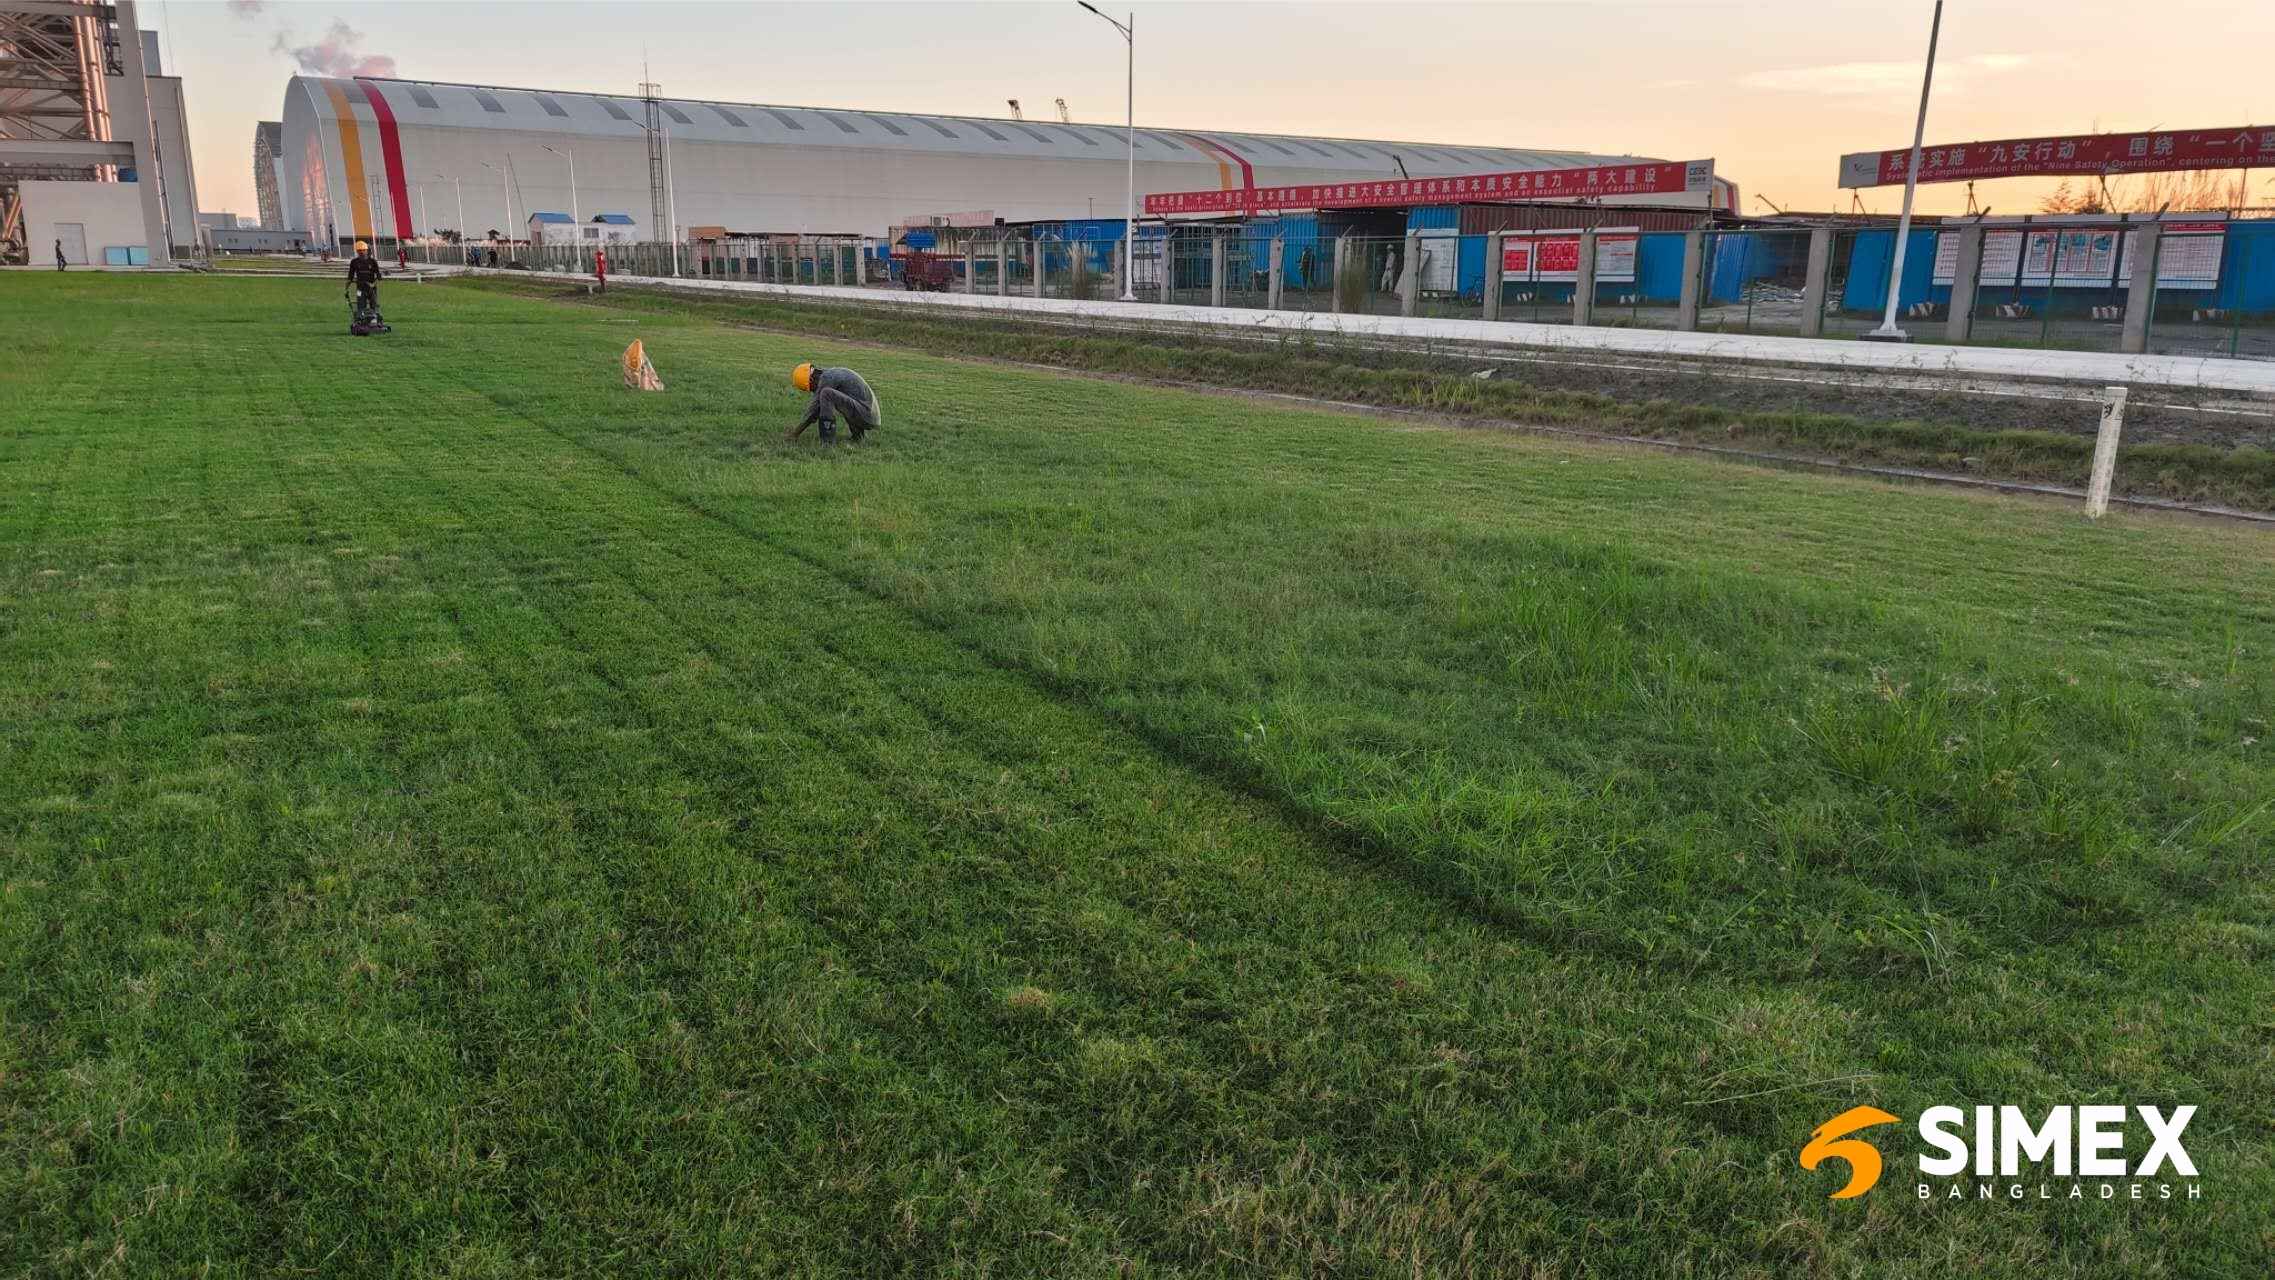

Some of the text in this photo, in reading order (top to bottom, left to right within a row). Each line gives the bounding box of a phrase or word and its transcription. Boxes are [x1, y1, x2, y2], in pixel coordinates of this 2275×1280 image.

[1936, 164, 2008, 177] implementation
[2011, 162, 2021, 172] of
[2024, 162, 2040, 171] the
[2178, 154, 2234, 167] centering
[2238, 156, 2253, 164] on
